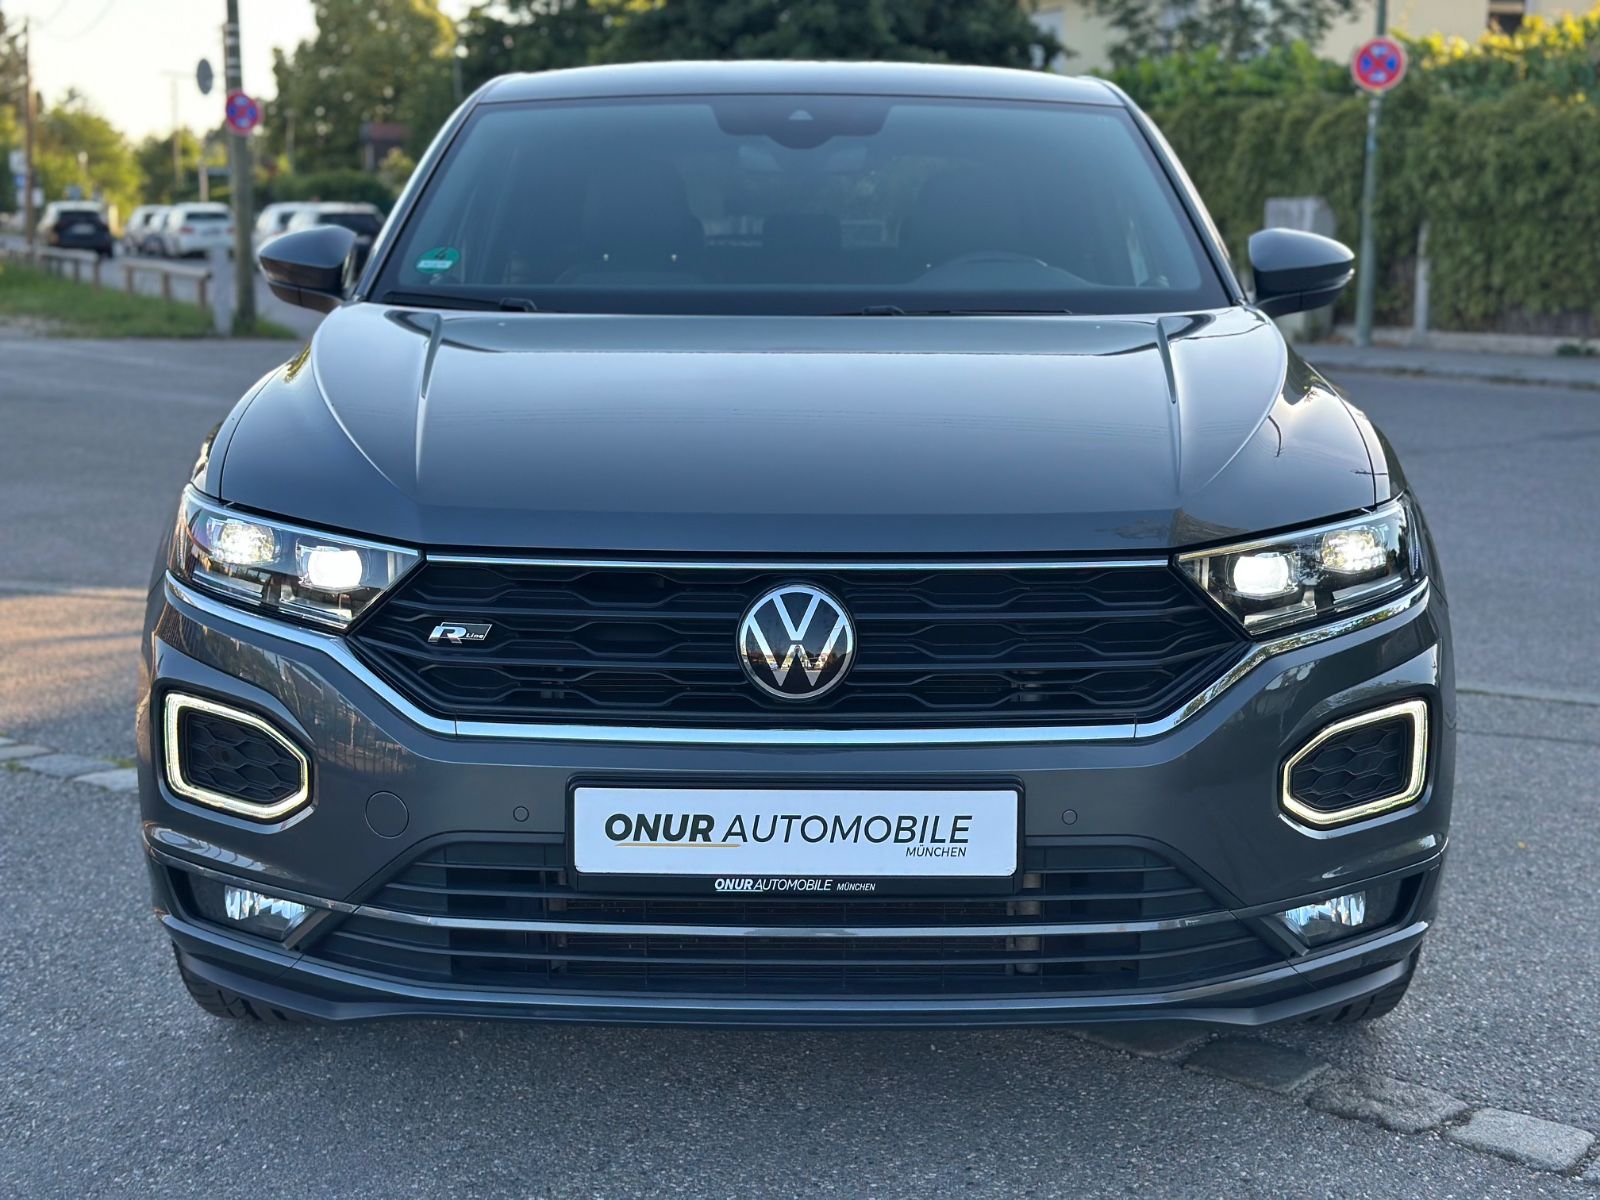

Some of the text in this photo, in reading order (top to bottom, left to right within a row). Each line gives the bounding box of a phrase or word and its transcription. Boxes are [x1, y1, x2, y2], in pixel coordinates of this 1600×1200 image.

[605, 813, 973, 843] ONUR AUTOMOBILE
[905, 844, 967, 857] MÜNCHEN
[714, 878, 876, 891] ONUR AUTOMOBILE MÜNCHEN
